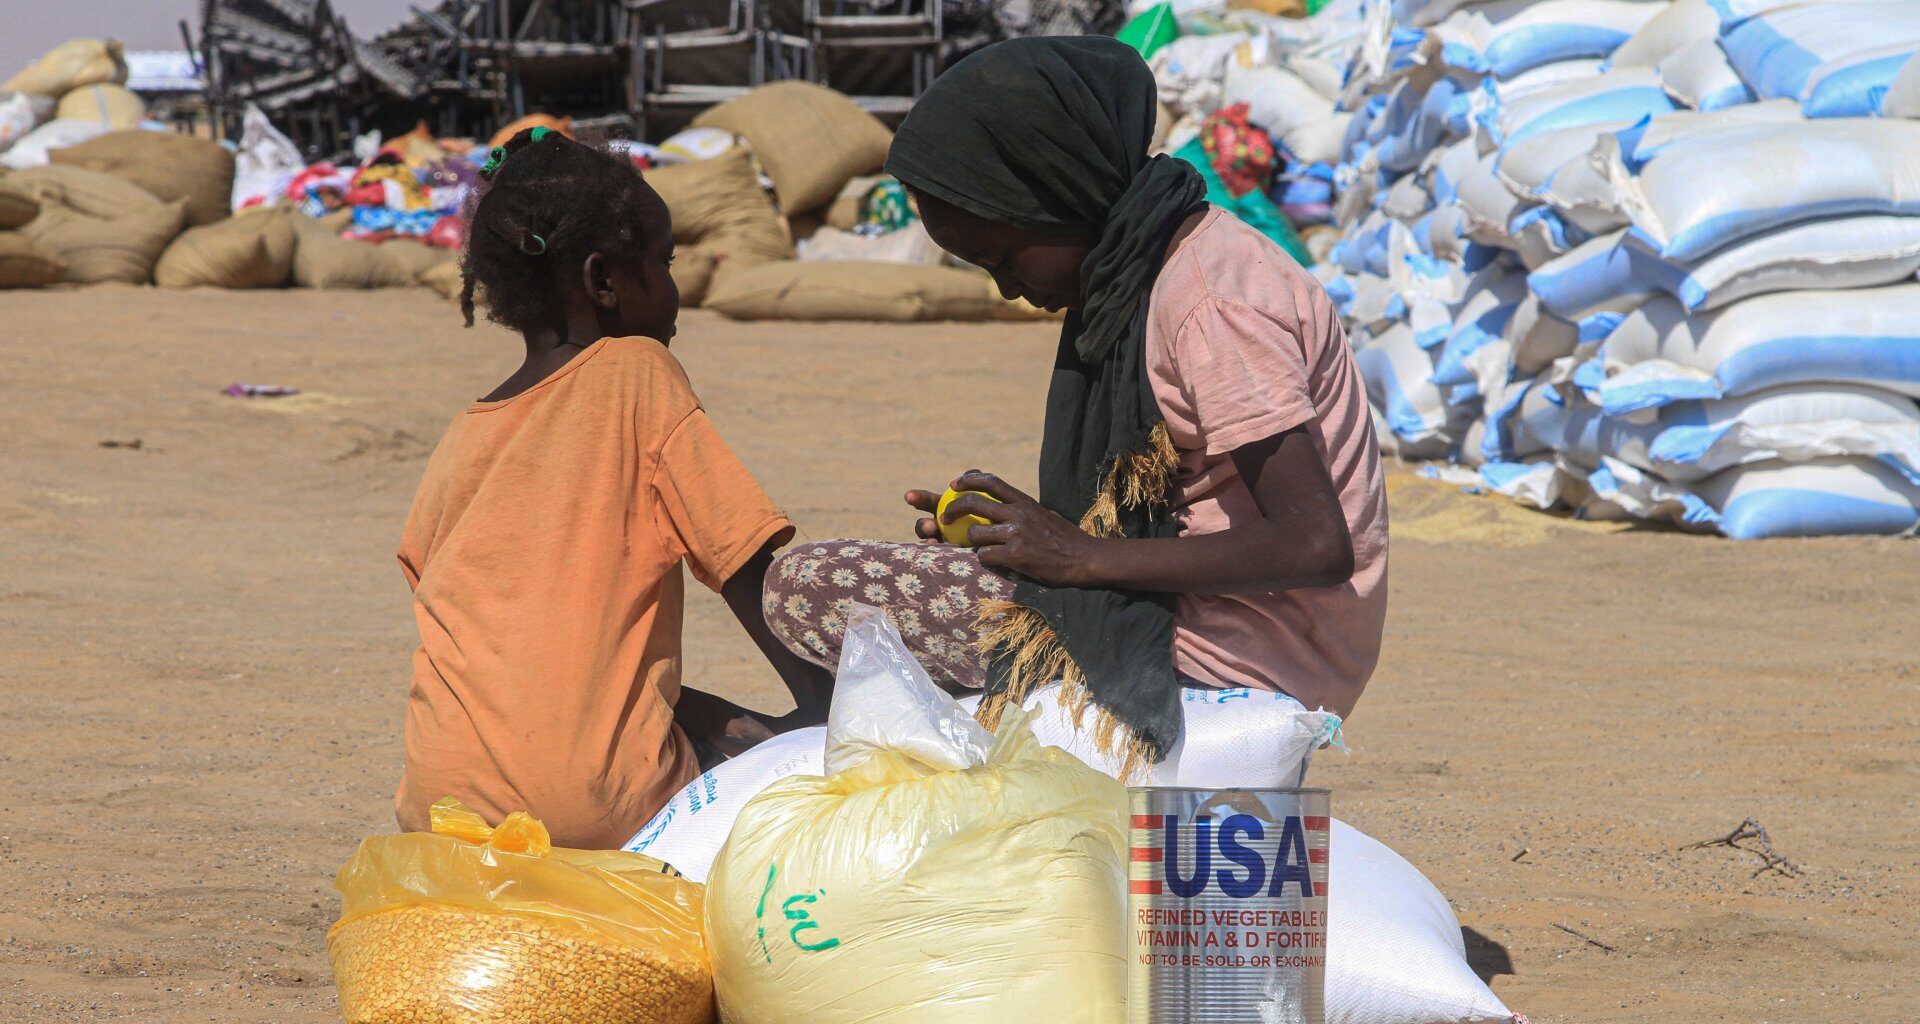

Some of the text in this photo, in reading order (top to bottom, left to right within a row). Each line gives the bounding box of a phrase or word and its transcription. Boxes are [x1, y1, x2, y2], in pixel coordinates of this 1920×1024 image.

[1164, 814, 1313, 898] USA
[1137, 908, 1207, 926] REFINED
[1212, 910, 1317, 927] VEGETABLE
[1136, 930, 1199, 948] VITAMIN
[1204, 931, 1219, 947] A
[1224, 931, 1239, 948] &
[1245, 931, 1259, 948] D
[1139, 953, 1158, 965] NOT
[1161, 954, 1177, 966] TO
[1182, 955, 1201, 966] BE
[1205, 955, 1245, 967] SOLD
[1250, 955, 1271, 967] OR
